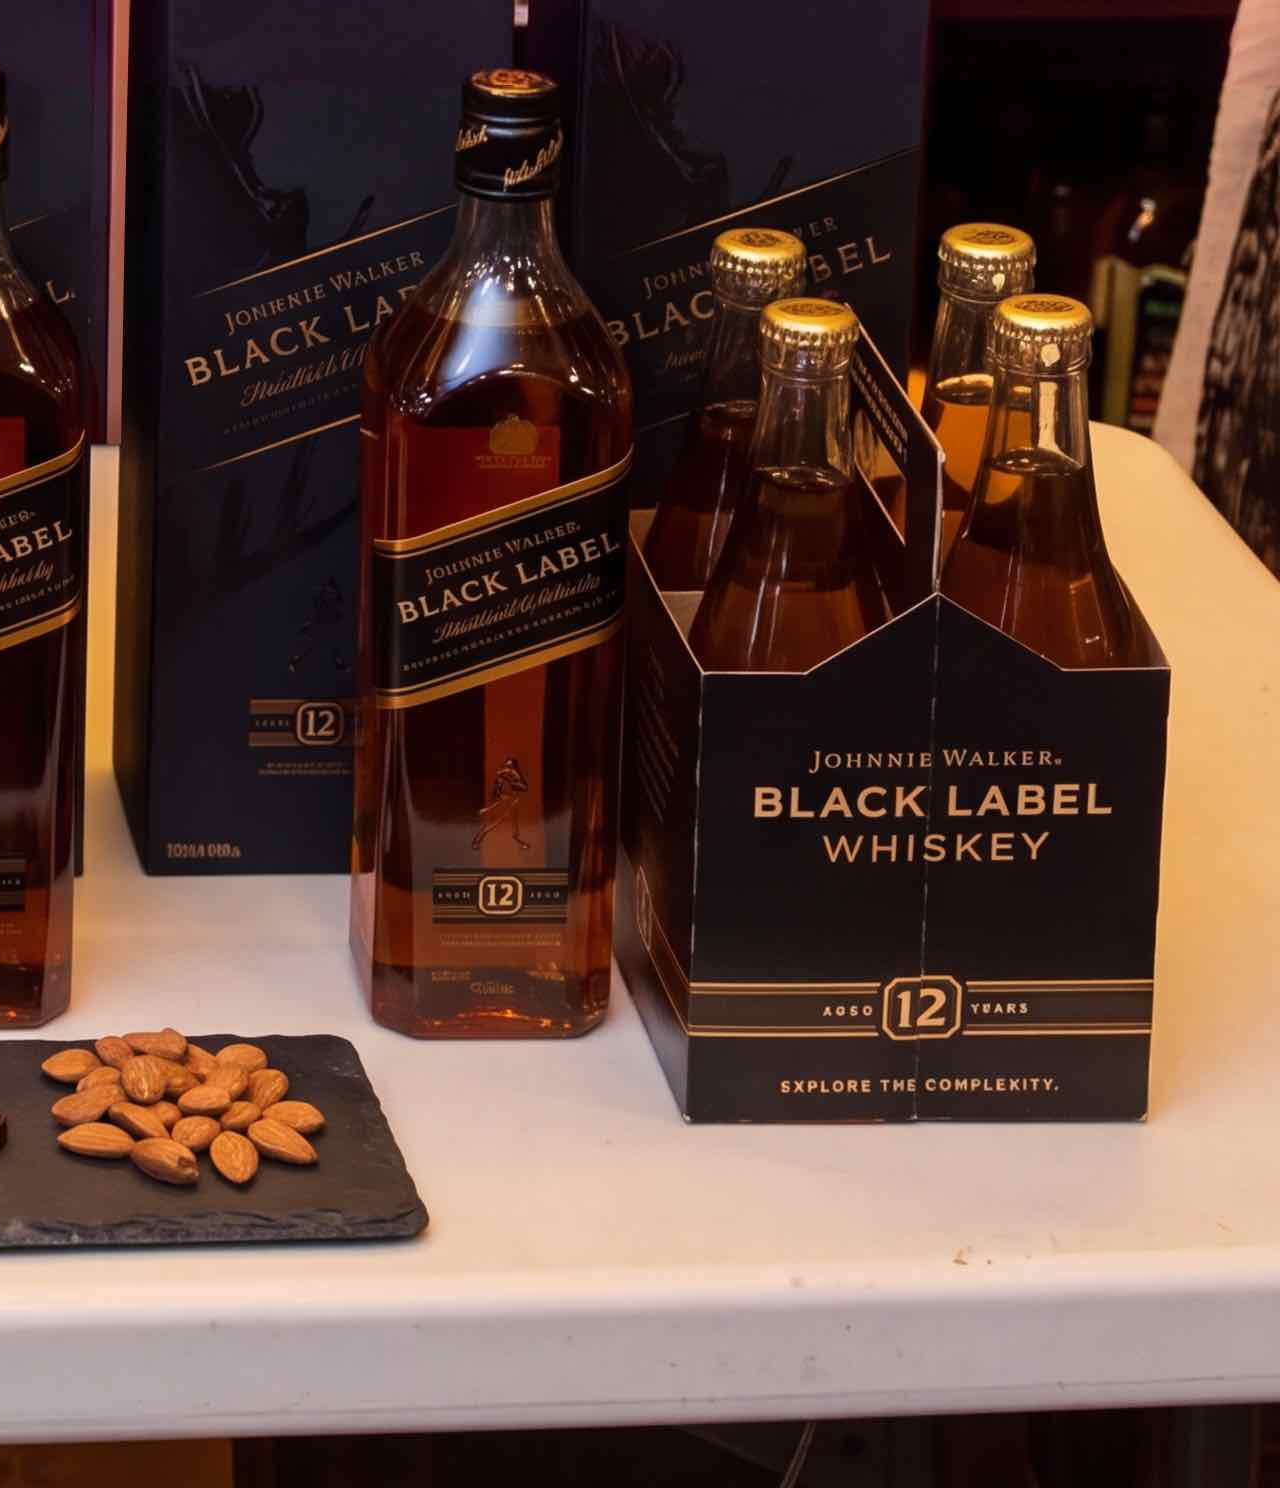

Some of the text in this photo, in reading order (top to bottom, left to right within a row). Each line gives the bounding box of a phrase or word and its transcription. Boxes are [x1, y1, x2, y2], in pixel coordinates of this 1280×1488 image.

[329, 250, 425, 292] WALKER
[609, 289, 714, 346] BLAC
[184, 315, 330, 387] BLACK
[397, 572, 509, 624] BLACK
[517, 532, 622, 586] LABEL
[305, 710, 335, 736] 12
[809, 751, 932, 773] JOHNNIE
[753, 783, 1113, 819] BLACK LABEL
[823, 831, 1050, 863] WHISKEY
[486, 882, 513, 907] 12
[897, 988, 946, 1028] 12
[880, 1079, 917, 1092] THE
